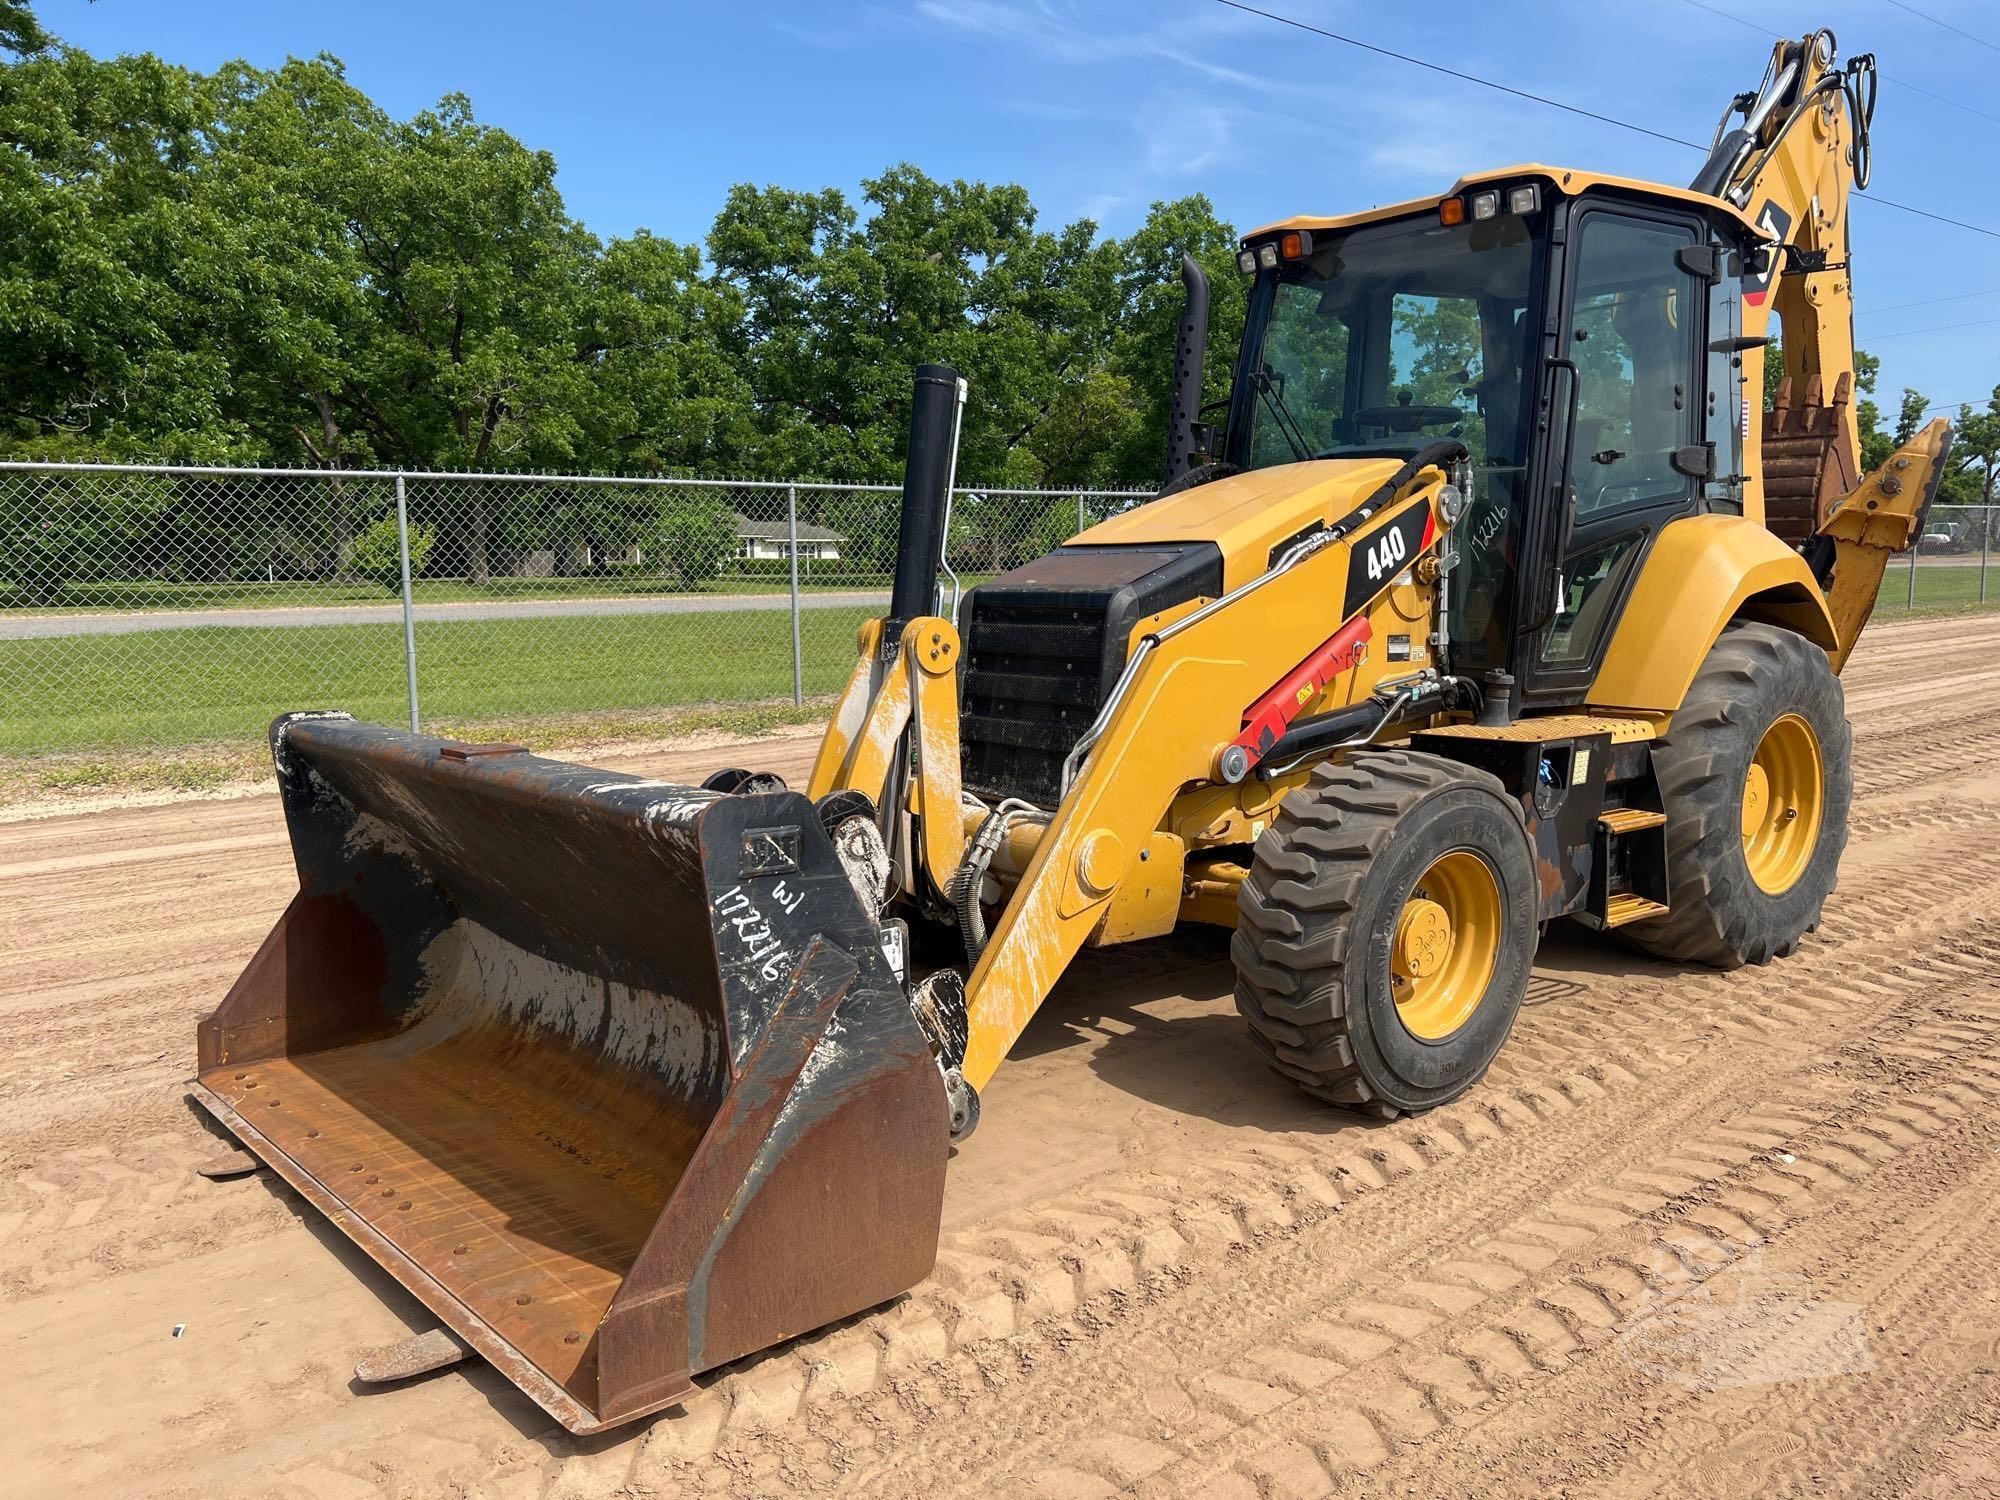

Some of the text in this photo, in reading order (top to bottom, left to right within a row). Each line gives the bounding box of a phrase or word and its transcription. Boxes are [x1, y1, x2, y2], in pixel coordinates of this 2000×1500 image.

[1368, 526, 1406, 580] 440
[1468, 505, 1509, 561] 172216
[715, 885, 788, 981] 172216
